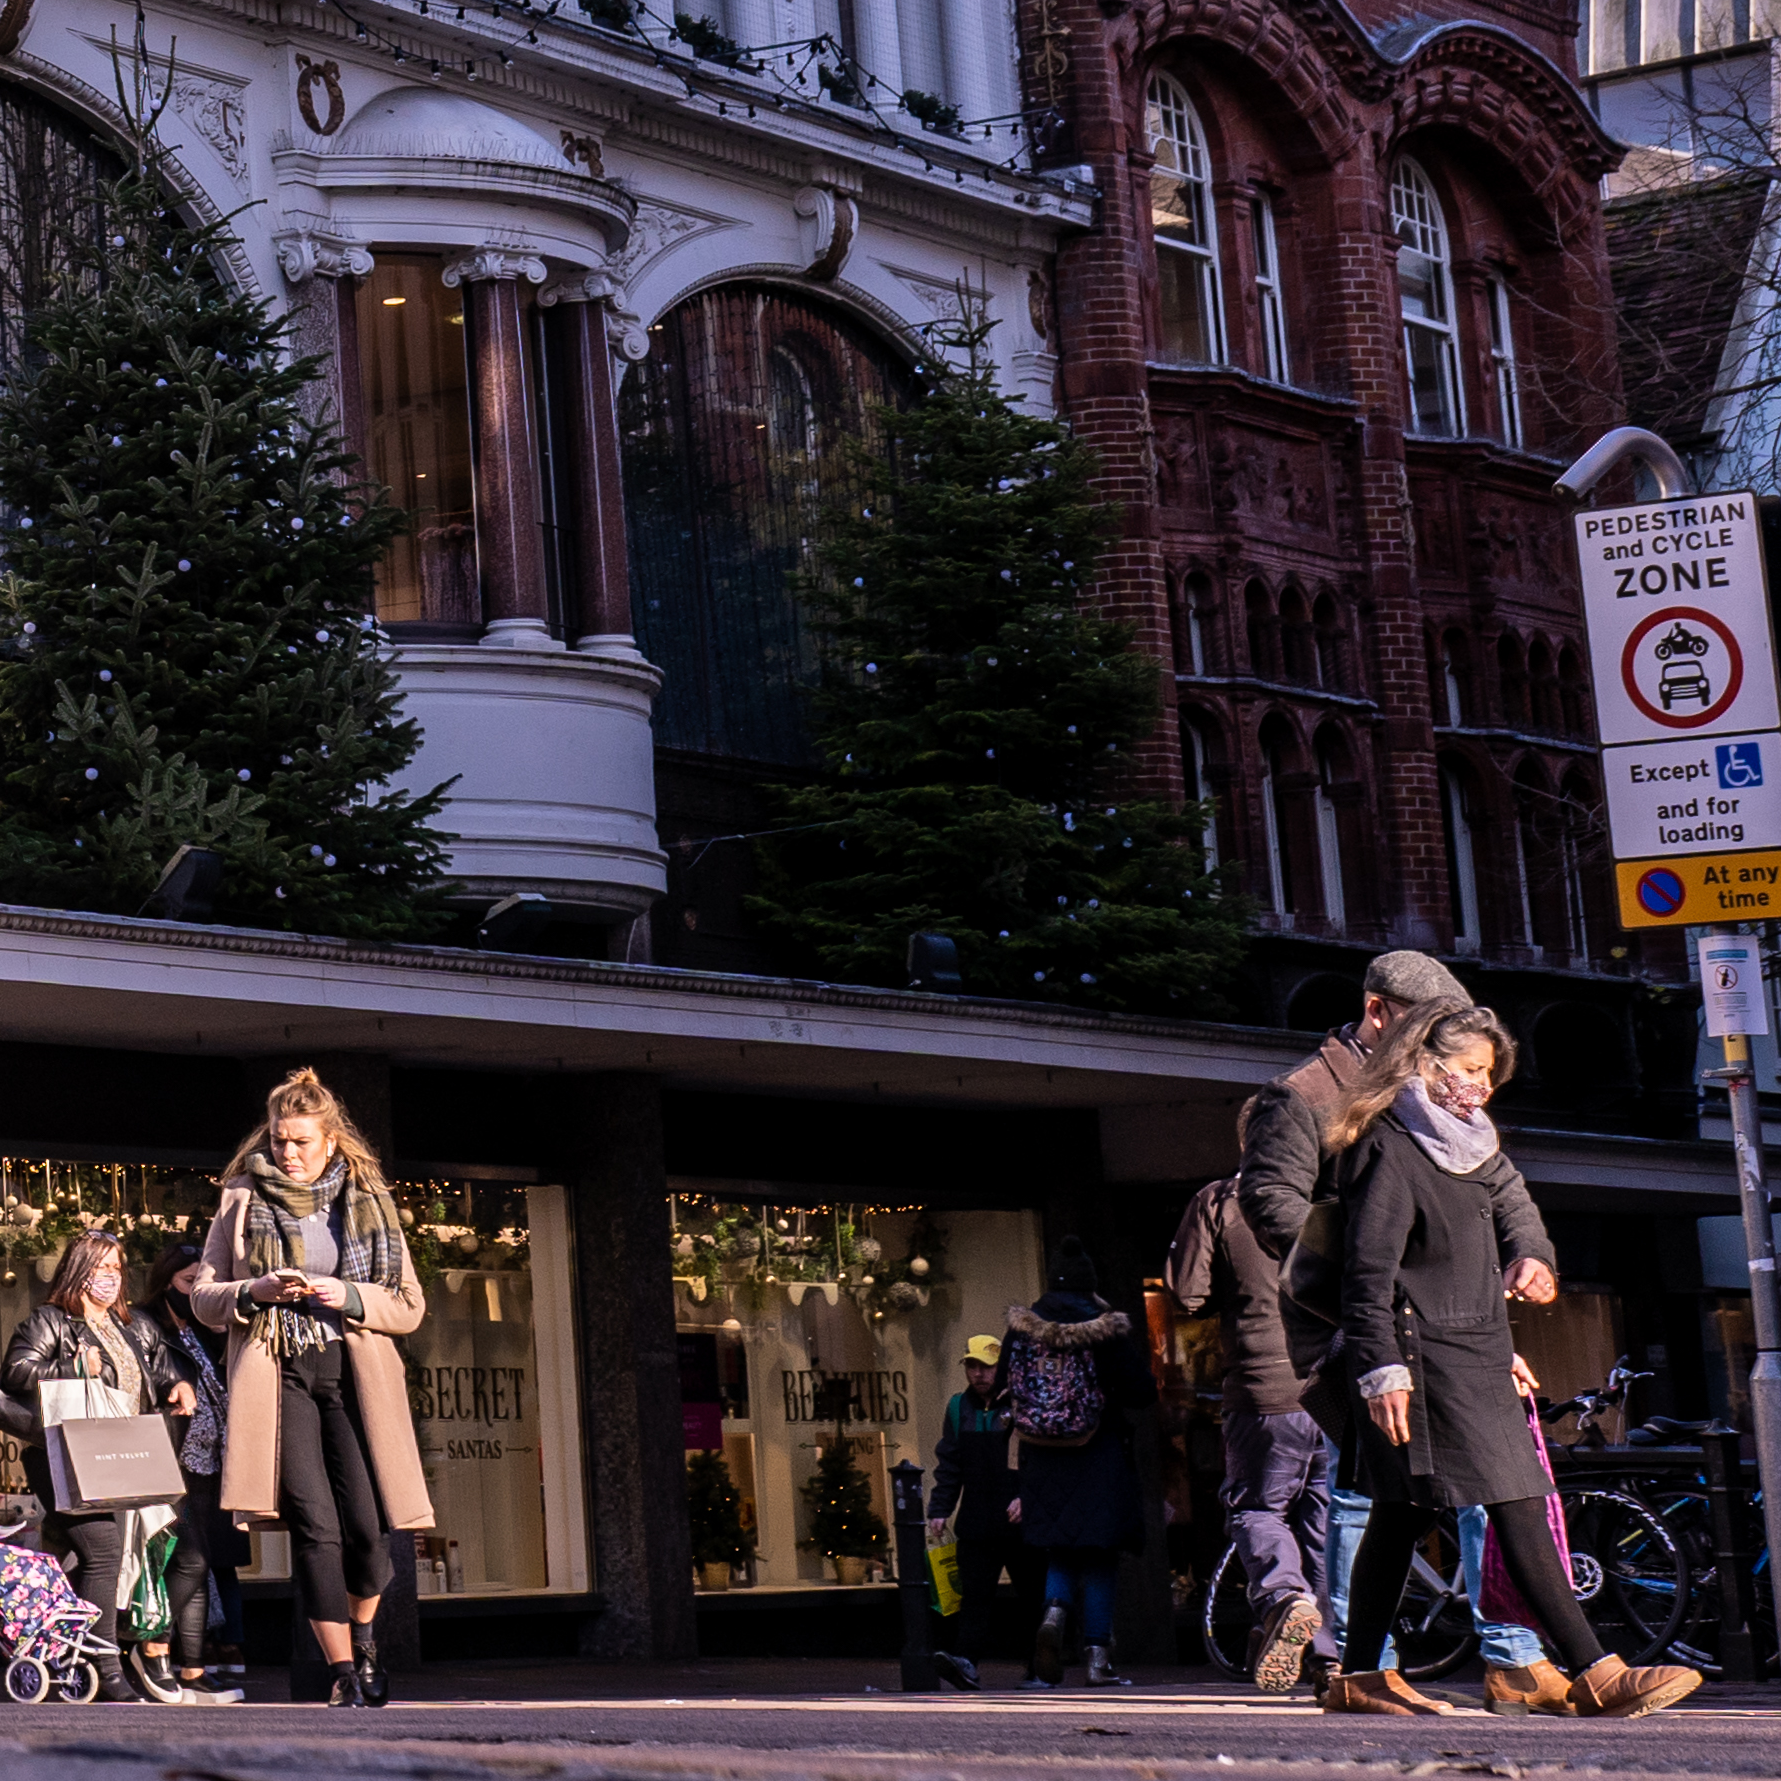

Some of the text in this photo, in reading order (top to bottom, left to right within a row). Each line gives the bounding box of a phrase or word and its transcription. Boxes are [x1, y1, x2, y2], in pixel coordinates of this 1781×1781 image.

[1585, 501, 1746, 539] PEDESTRIAN
[1603, 528, 1735, 561] and CYCLE
[1614, 557, 1731, 599] ZONE
[1630, 759, 1711, 784] Except
[1657, 796, 1741, 820] and for
[1659, 822, 1744, 844] loading
[1703, 865, 1780, 886] At any
[1718, 889, 1770, 910] time
[418, 1366, 525, 1428] SECRET
[447, 1439, 503, 1460] SANTAS
